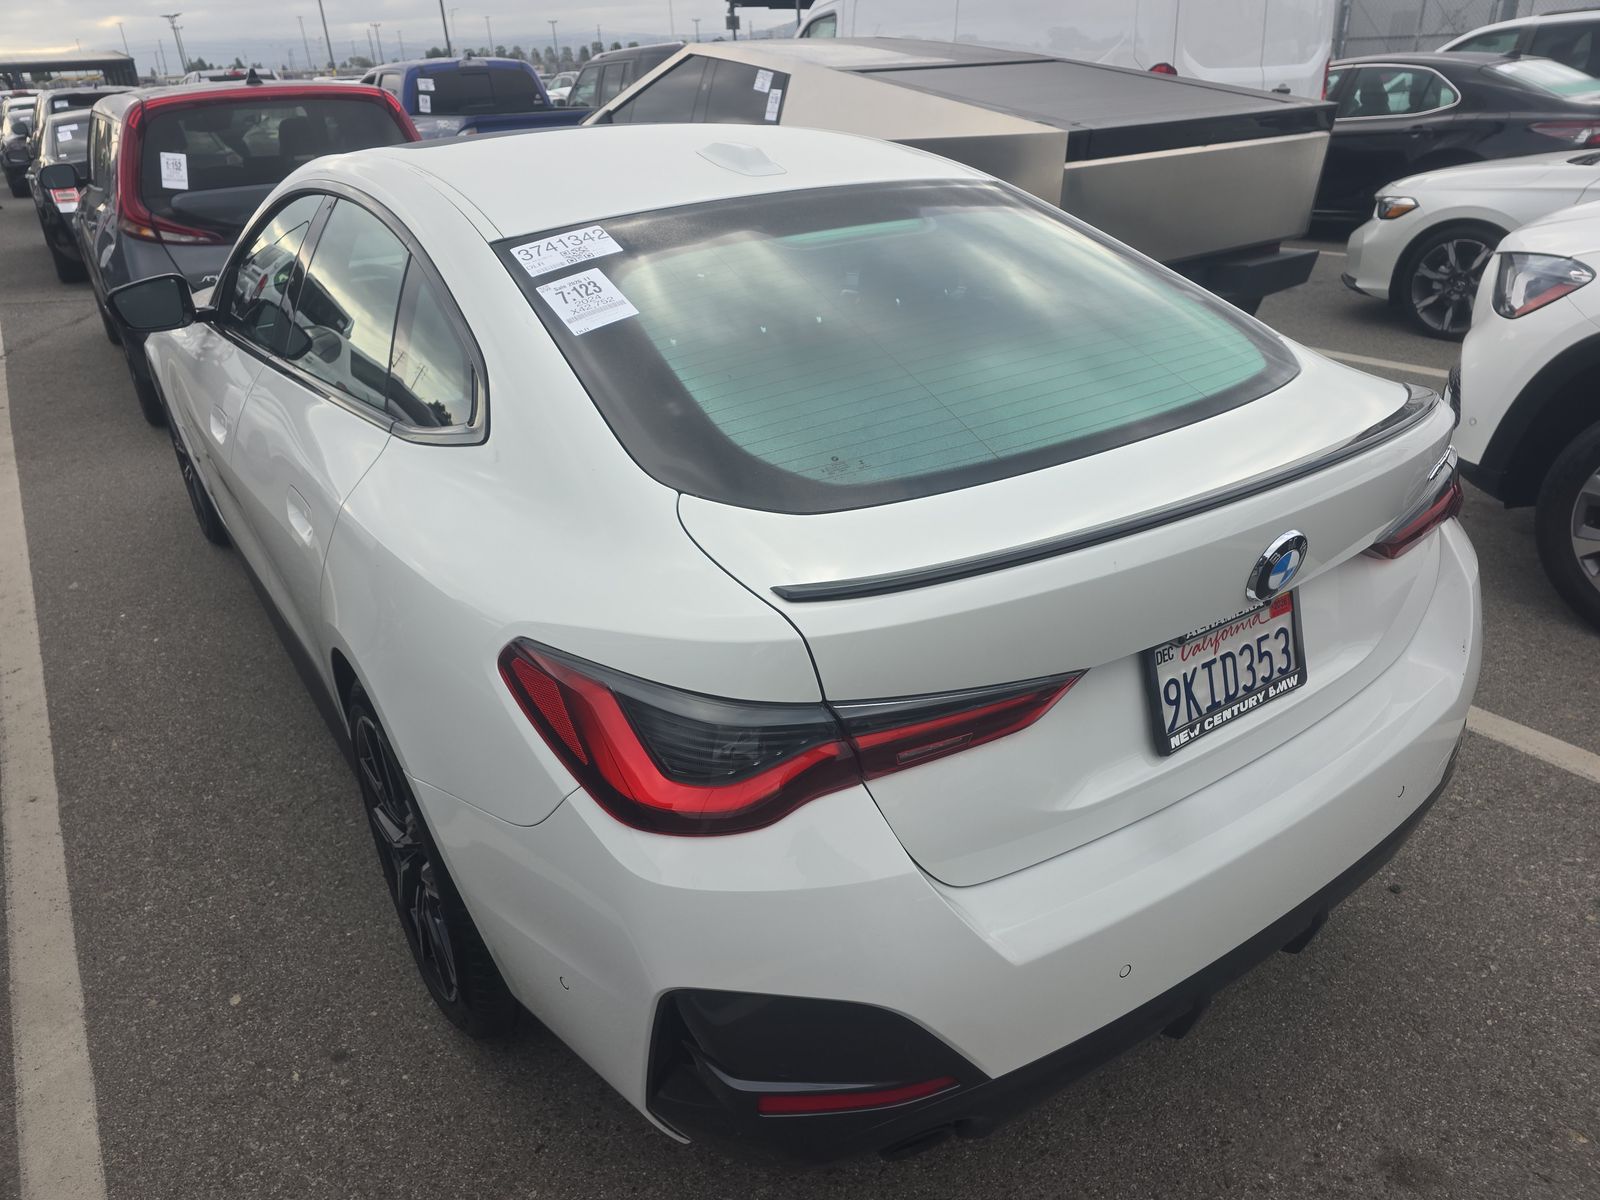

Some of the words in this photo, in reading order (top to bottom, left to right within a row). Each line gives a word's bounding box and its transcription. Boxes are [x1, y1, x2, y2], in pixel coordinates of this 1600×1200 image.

[517, 228, 609, 261] 3741342
[555, 280, 602, 304] 7:123
[574, 294, 602, 308] 2024
[1180, 613, 1271, 663] California
[1156, 646, 1175, 666] DEC
[1163, 627, 1292, 733] 9KID353
[1169, 722, 1201, 749] NEW
[1204, 690, 1266, 731] CENTURY
[1268, 674, 1299, 698] BMW
